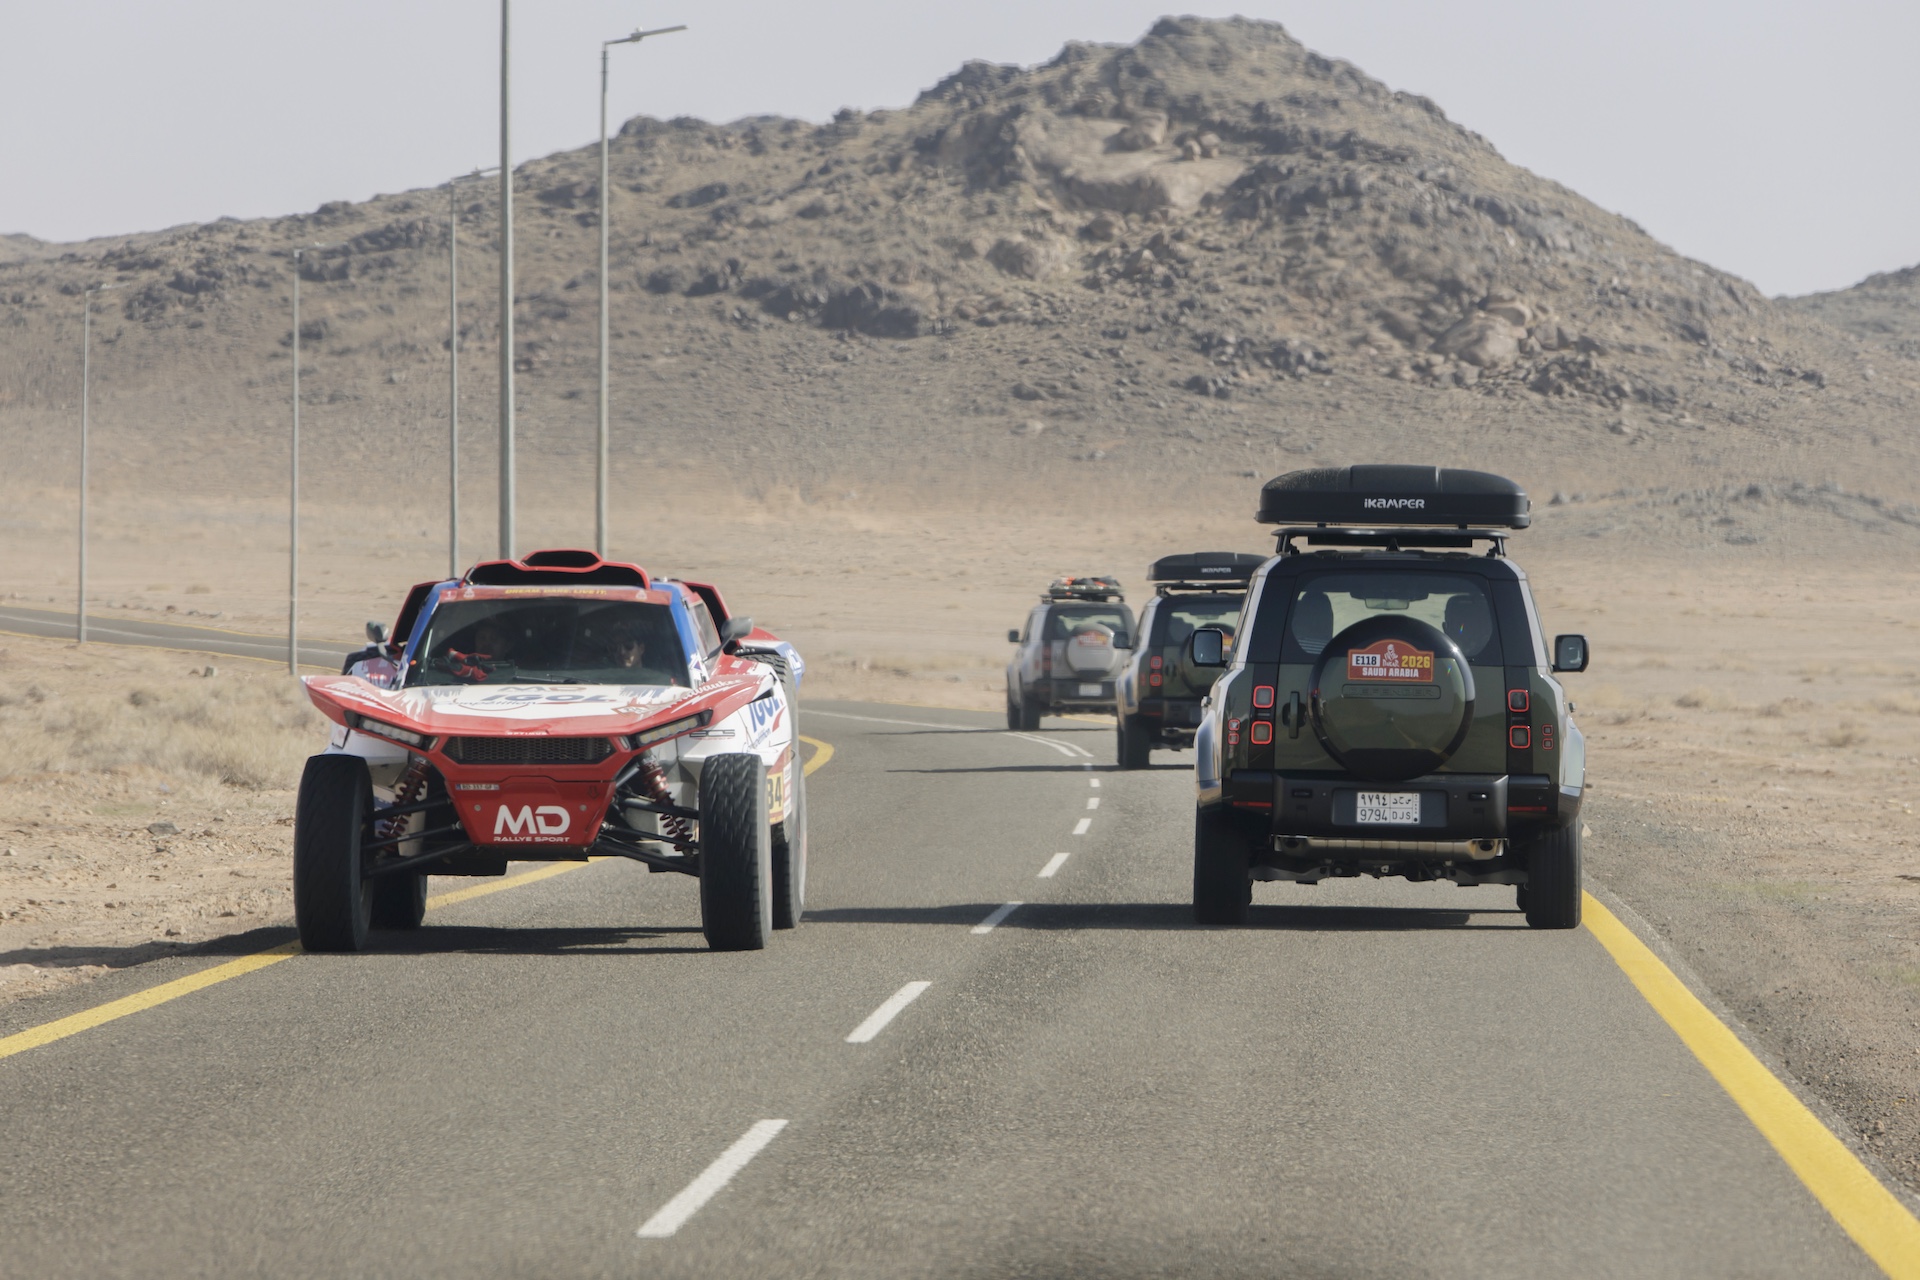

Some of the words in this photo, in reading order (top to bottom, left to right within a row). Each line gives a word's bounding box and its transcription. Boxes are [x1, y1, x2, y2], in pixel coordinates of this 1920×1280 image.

[1355, 656, 1377, 665] E118
[1401, 655, 1431, 668] 2026
[1362, 667, 1387, 677] SAUDI
[1389, 668, 1419, 677] ARABIA
[494, 805, 570, 834] MD
[1360, 809, 1388, 821] 9794
[1392, 811, 1411, 820] DJS
